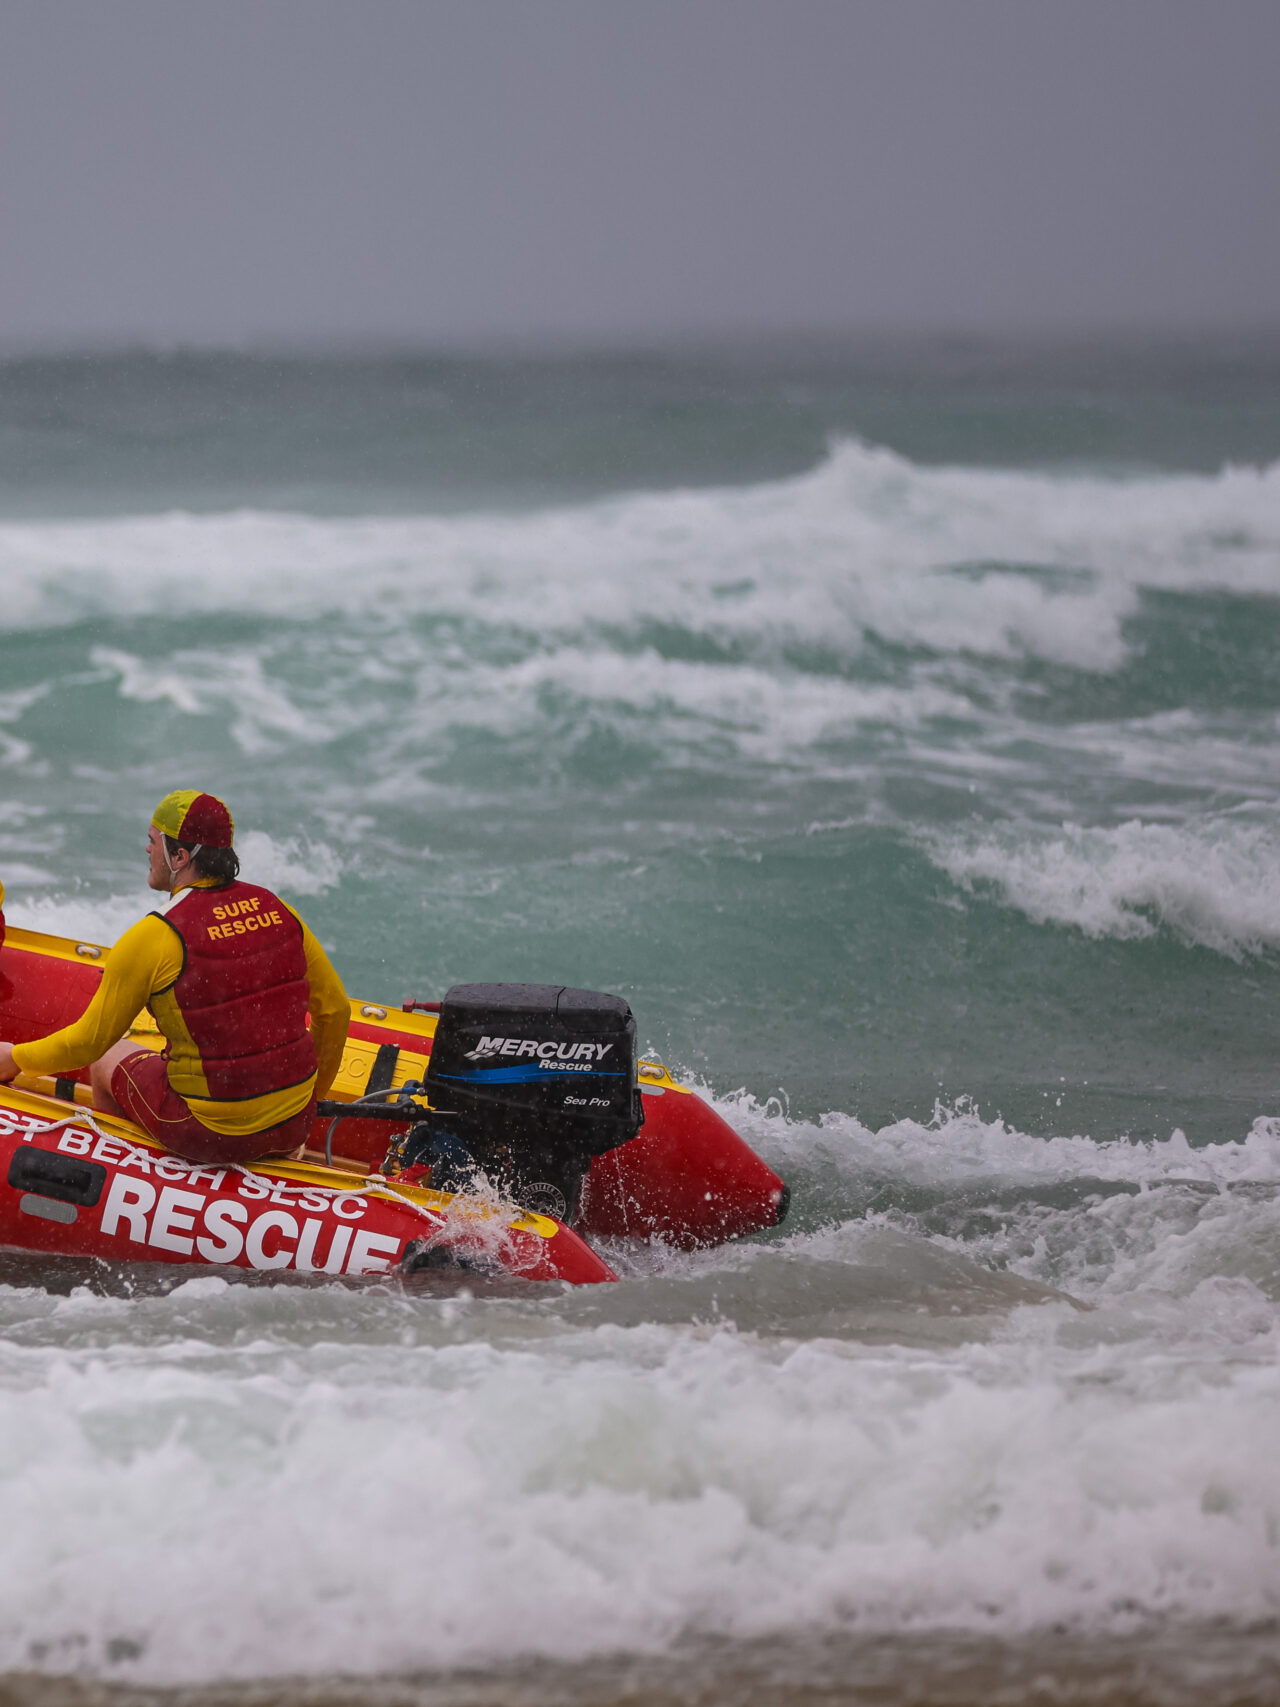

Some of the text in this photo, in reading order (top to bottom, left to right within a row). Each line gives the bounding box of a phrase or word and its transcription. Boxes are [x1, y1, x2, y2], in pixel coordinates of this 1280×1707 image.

[212, 897, 261, 920] SURF
[207, 911, 283, 941] RESCUE
[464, 1036, 614, 1061] MERCURY
[538, 1058, 593, 1072] Rescue
[563, 1095, 611, 1108] Sea Pro
[56, 1127, 227, 1191] BEACH
[237, 1175, 368, 1220] SLSC
[100, 1172, 401, 1276] RESCUE
